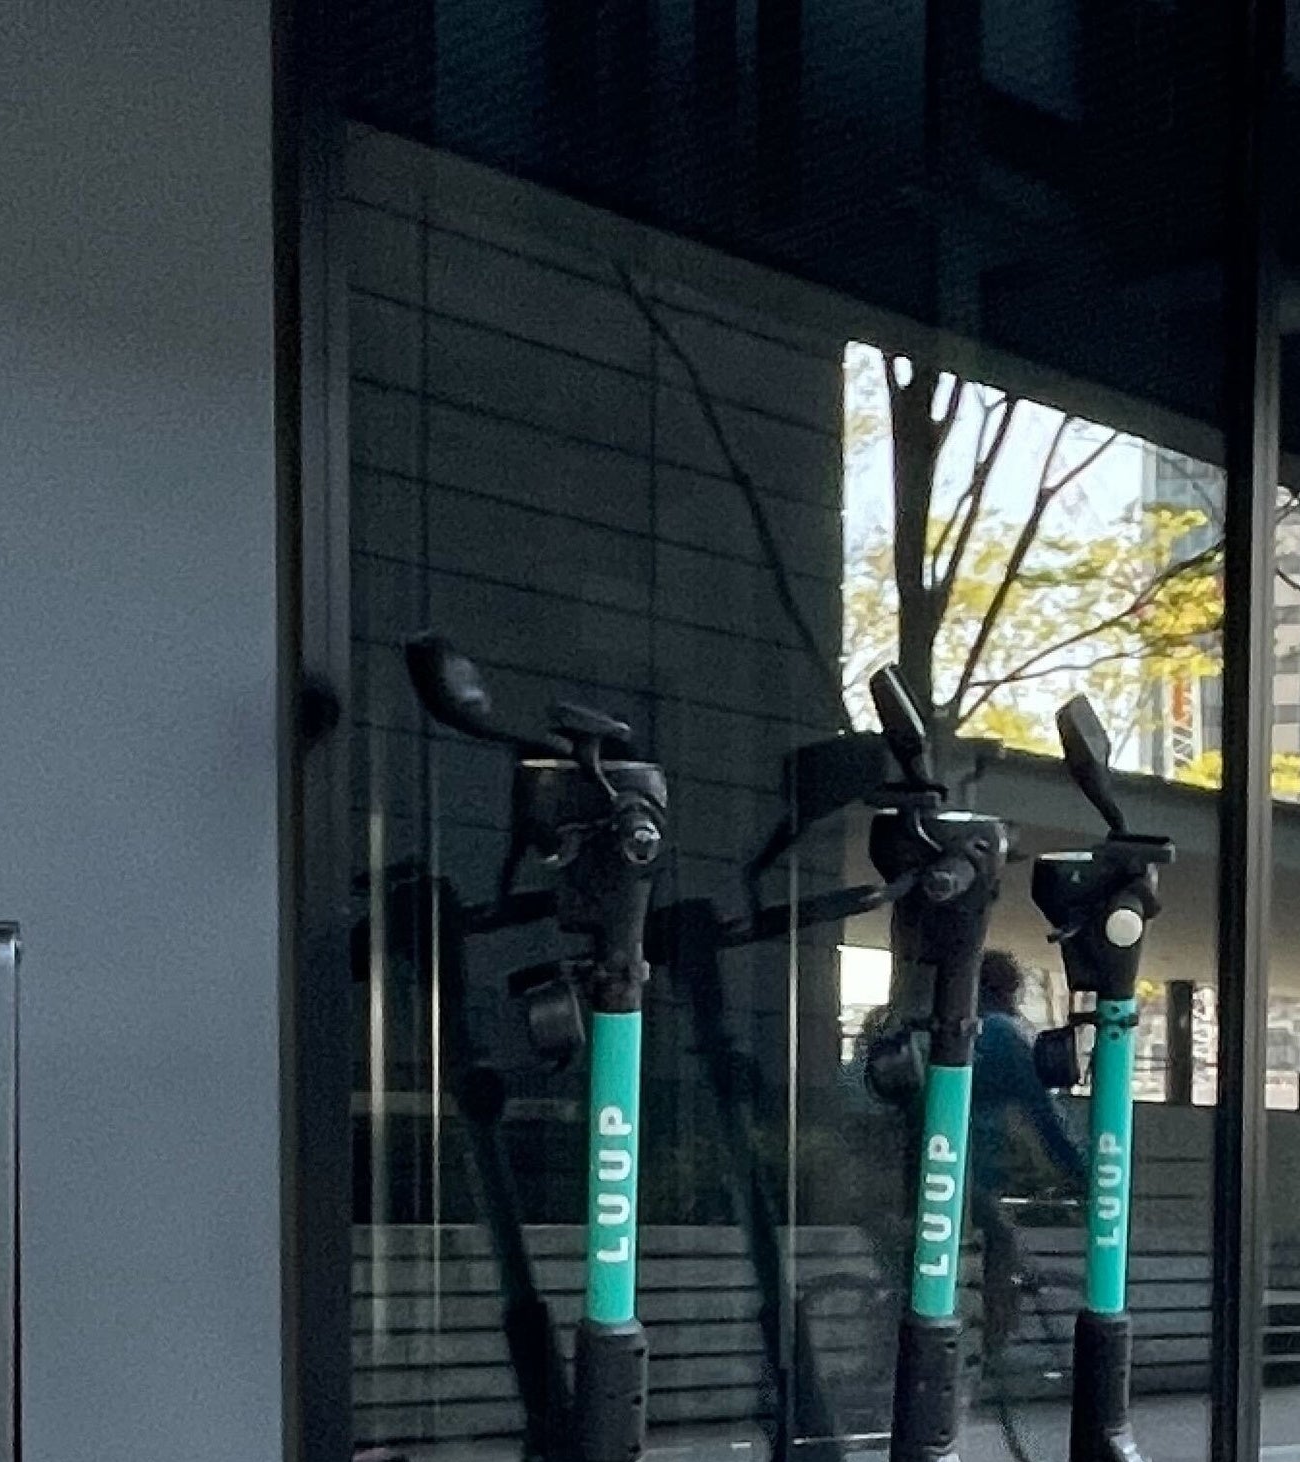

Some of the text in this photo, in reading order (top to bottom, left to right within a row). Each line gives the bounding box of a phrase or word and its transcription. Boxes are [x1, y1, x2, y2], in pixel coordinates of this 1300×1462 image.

[596, 1105, 634, 1263] LUUP
[919, 1133, 958, 1277] LUUP
[1095, 1131, 1123, 1247] LUUP
